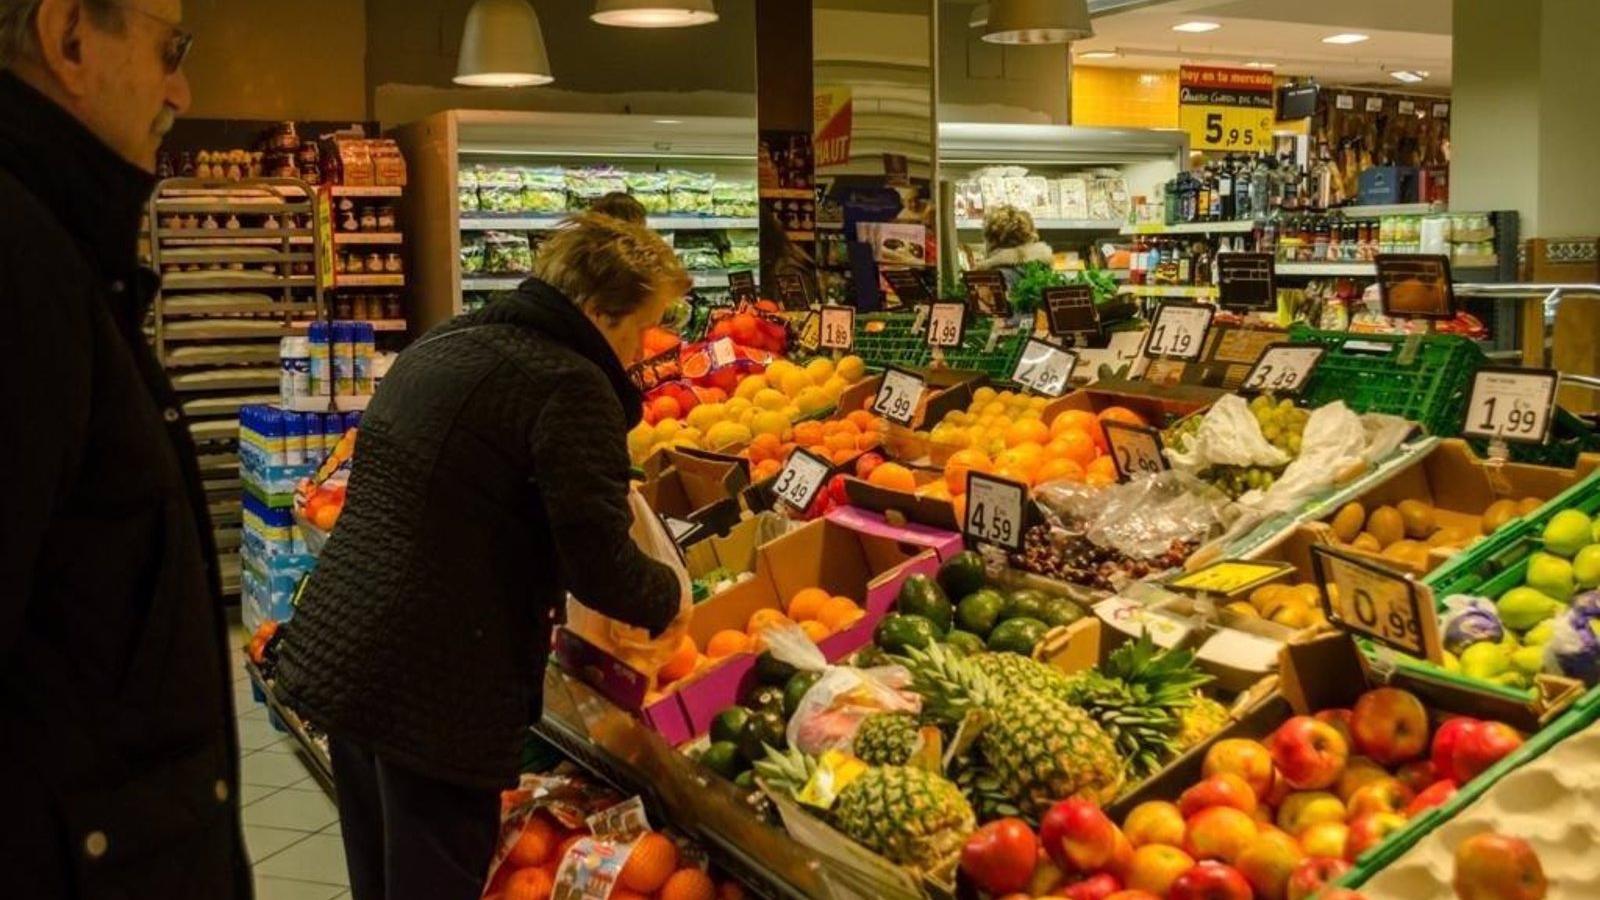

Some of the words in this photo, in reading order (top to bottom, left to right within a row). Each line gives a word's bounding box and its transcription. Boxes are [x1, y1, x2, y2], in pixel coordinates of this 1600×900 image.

[1201, 72, 1215, 81] en
[1230, 73, 1273, 86] mercado
[930, 319, 956, 344] 1,99
[1151, 325, 1191, 356] 1,19
[877, 385, 910, 416] 2,99
[1479, 397, 1536, 435] 1,99
[1117, 445, 1159, 473] 299
[776, 469, 808, 502] 3,49
[971, 502, 1011, 541] 4,59
